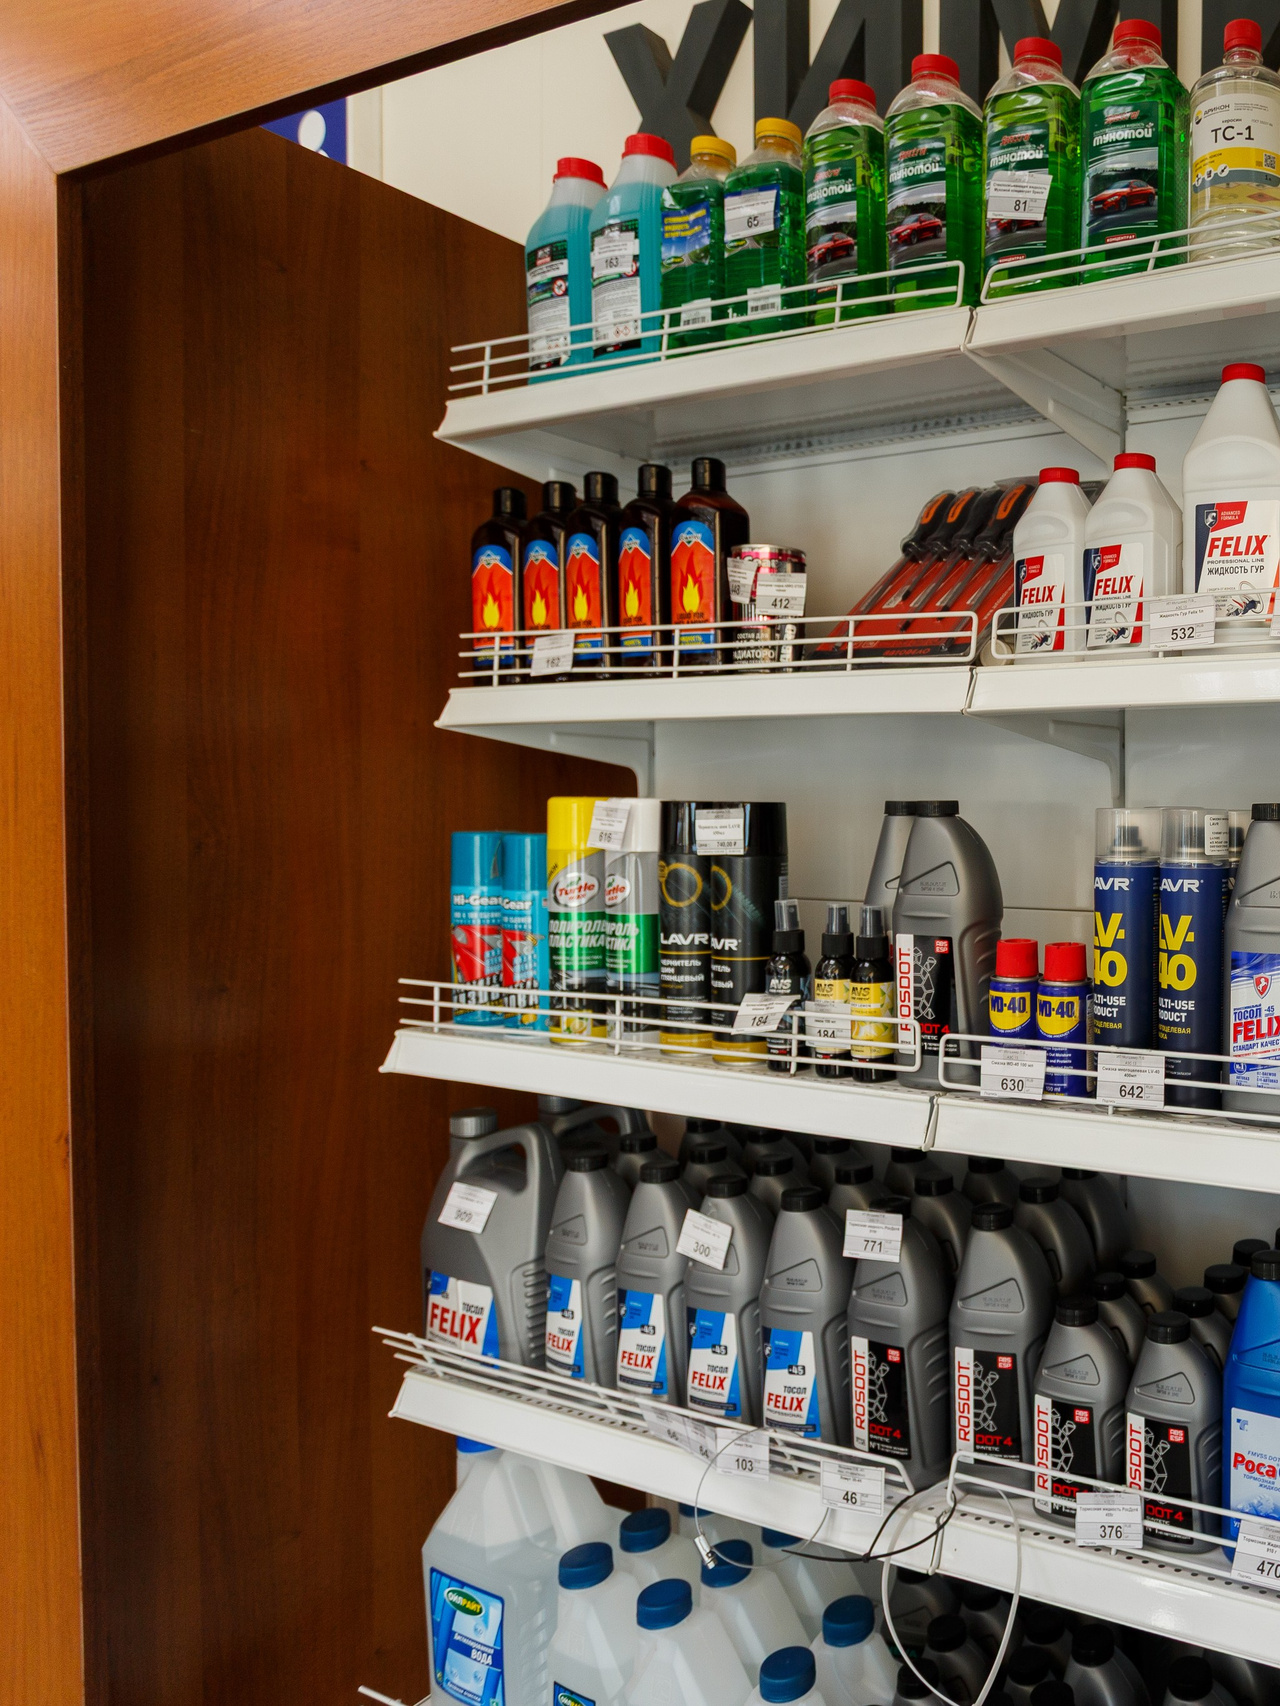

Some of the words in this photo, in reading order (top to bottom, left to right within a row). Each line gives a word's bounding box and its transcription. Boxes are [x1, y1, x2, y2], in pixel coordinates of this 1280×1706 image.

[1013, 199, 1028, 212] 81
[746, 215, 760, 229] 65
[604, 257, 620, 269] 163
[1207, 534, 1269, 558] FELIX
[1207, 565, 1249, 576] ЖИДКОСТЬ
[1250, 565, 1265, 574] ГУР
[1095, 575, 1133, 597] FELIX
[1021, 585, 1055, 605] FELIX
[771, 598, 790, 609] 412
[1021, 610, 1045, 619] ЖИДКОСТЬ
[1045, 609, 1054, 618] ГУР
[1171, 626, 1195, 641] 532
[558, 882, 596, 897] Turtle
[660, 932, 709, 945] LAVR
[990, 996, 1027, 1014] WD-40
[1038, 999, 1076, 1018] WD-40
[751, 1015, 769, 1027] 184
[1233, 1006, 1262, 1021] ТОСОЛ
[1233, 1040, 1260, 1052] СТАНДАРТ
[1001, 1077, 1024, 1091] 630
[1119, 1084, 1144, 1099] 642
[692, 1241, 711, 1257] 300
[864, 1239, 883, 1253] 771
[430, 1301, 481, 1344] FELIX
[547, 1332, 573, 1353] FELIX
[620, 1350, 654, 1369] FELIX
[691, 1370, 728, 1391] FELIX
[854, 1350, 866, 1430] ROSDOT
[767, 1392, 805, 1412] FELIX
[957, 1360, 971, 1441] ROSDOT
[869, 1422, 892, 1437] DOT
[892, 1426, 902, 1440] 4
[975, 1433, 1001, 1446] DOT
[1003, 1436, 1012, 1447] 4
[1247, 1450, 1266, 1460] FMVSS
[735, 1458, 754, 1472] 103
[1233, 1452, 1277, 1479] Роса
[1242, 1473, 1276, 1486] ТОРМОЗНАЯ
[842, 1490, 858, 1505] 46
[1145, 1504, 1173, 1520] DOT
[1173, 1510, 1184, 1522] 4
[1099, 1524, 1122, 1539] 376
[470, 1649, 493, 1666] ВОДА
